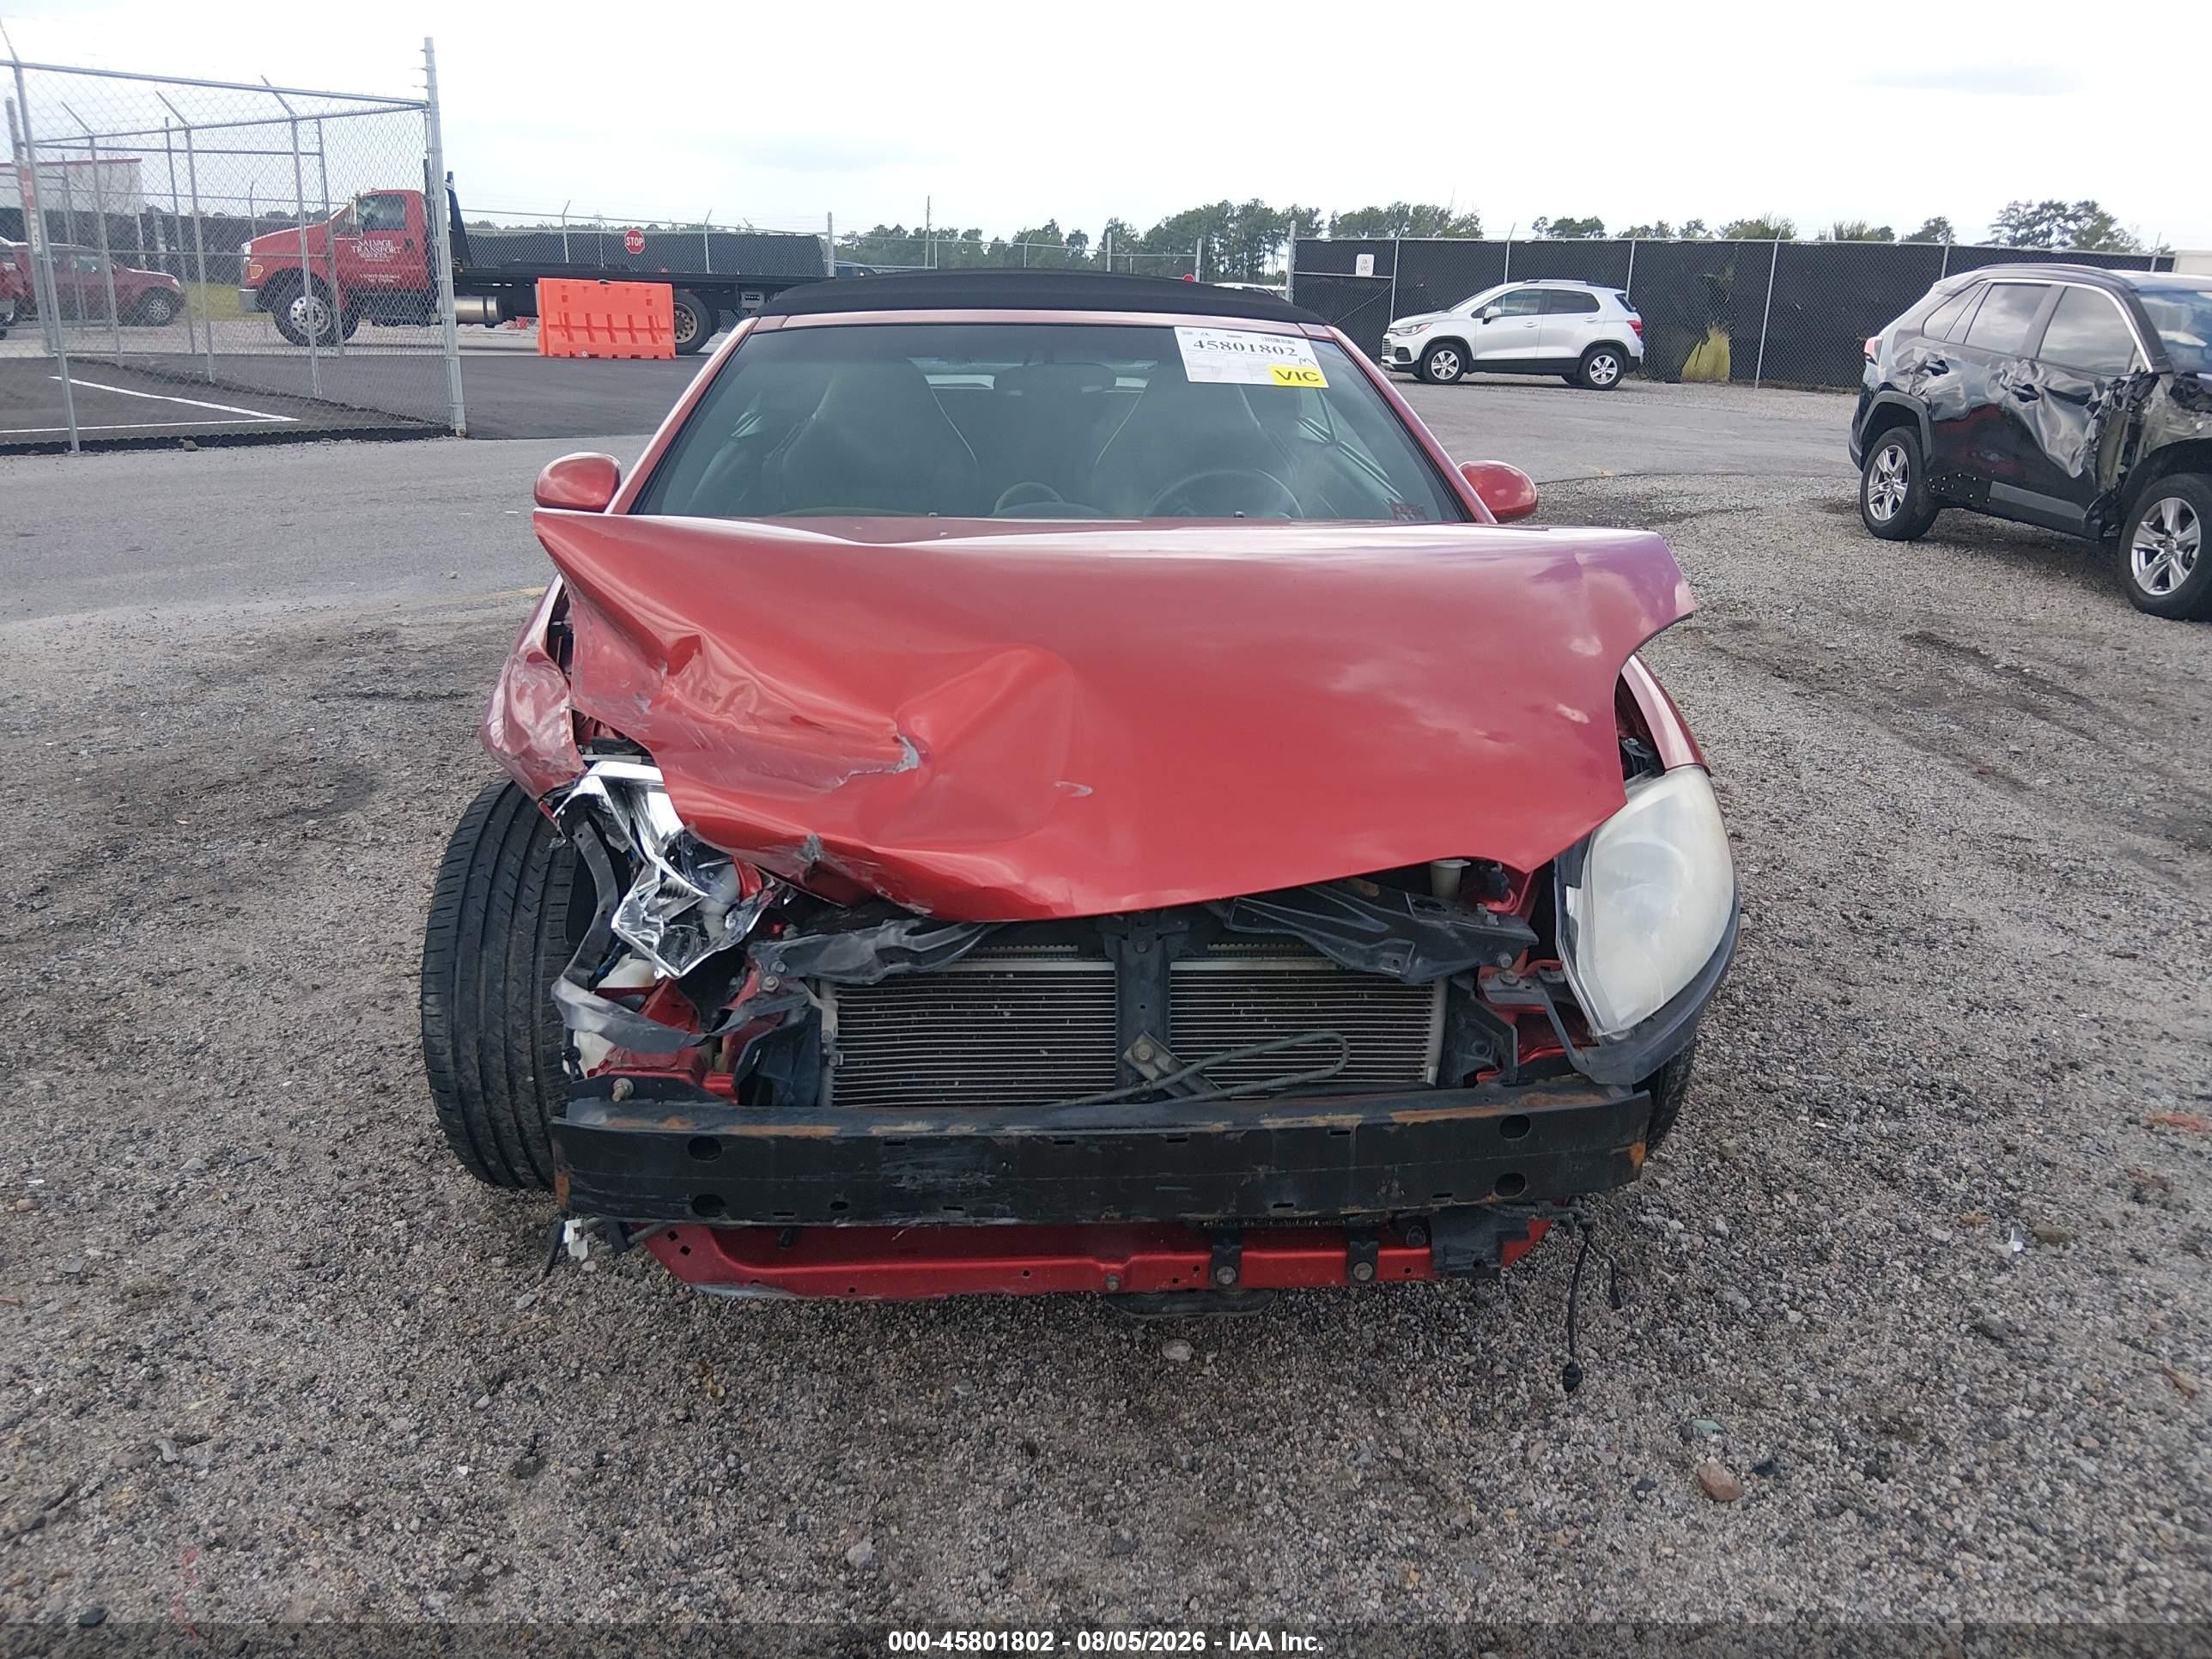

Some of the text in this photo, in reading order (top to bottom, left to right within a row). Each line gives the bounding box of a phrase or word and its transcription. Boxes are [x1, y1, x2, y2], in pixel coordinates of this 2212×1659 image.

[627, 236, 643, 246] STOP
[351, 246, 402, 254] TRANSPORT
[1194, 340, 1297, 356] 45801802
[1275, 370, 1320, 382] VIC
